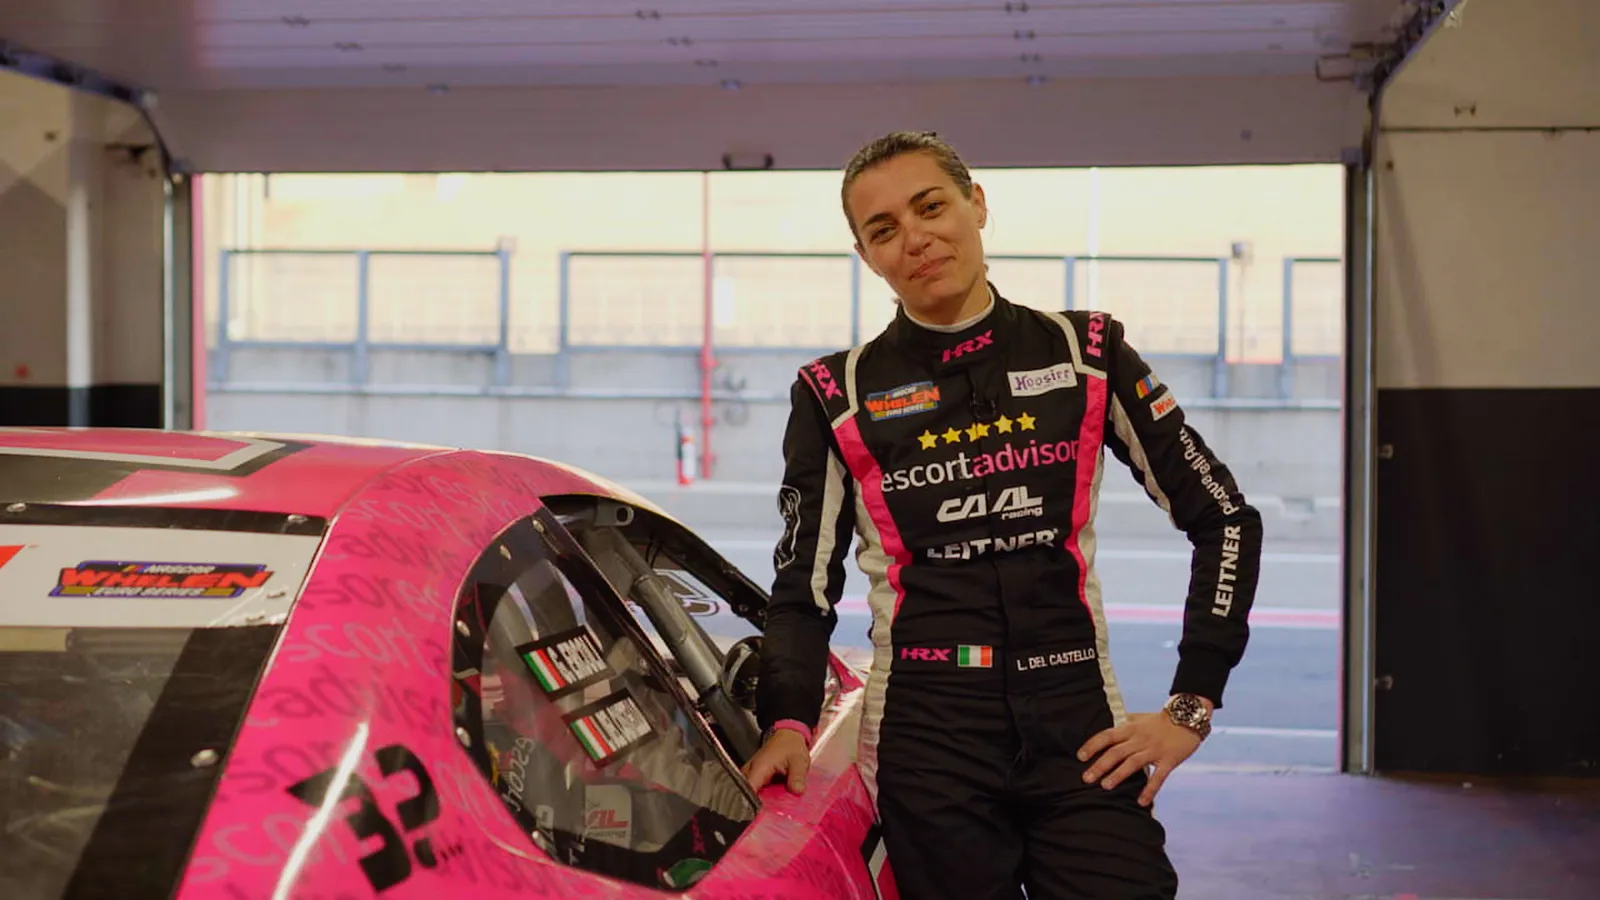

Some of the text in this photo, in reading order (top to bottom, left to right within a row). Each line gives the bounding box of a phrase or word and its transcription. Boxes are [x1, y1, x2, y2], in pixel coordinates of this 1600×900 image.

[942, 329, 994, 362] HRX
[879, 439, 1081, 492] escortadvisor
[1001, 506, 1043, 521] racing
[926, 529, 1056, 560] LEITNER
[60, 567, 275, 588] WHELEN
[1211, 525, 1241, 618] LEITNER
[901, 647, 952, 661] HRX
[1016, 648, 1096, 671] L. DEL CASTELLO
